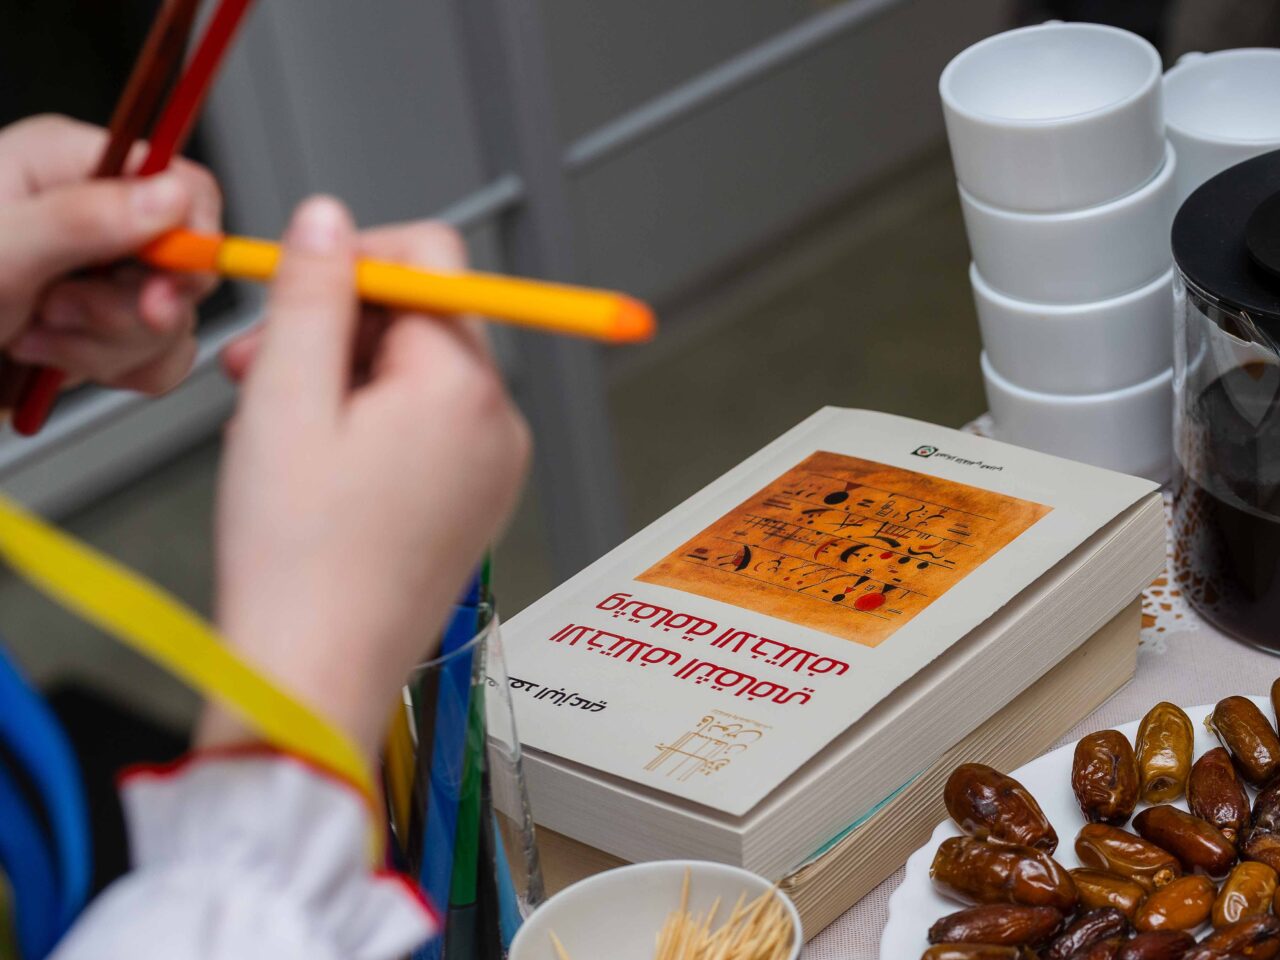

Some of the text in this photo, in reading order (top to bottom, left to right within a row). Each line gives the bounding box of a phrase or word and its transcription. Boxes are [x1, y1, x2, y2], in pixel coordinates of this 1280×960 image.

[548, 623, 816, 706] الاختلاف الثقافي
[596, 592, 850, 677] وثقافة الاختلاف
